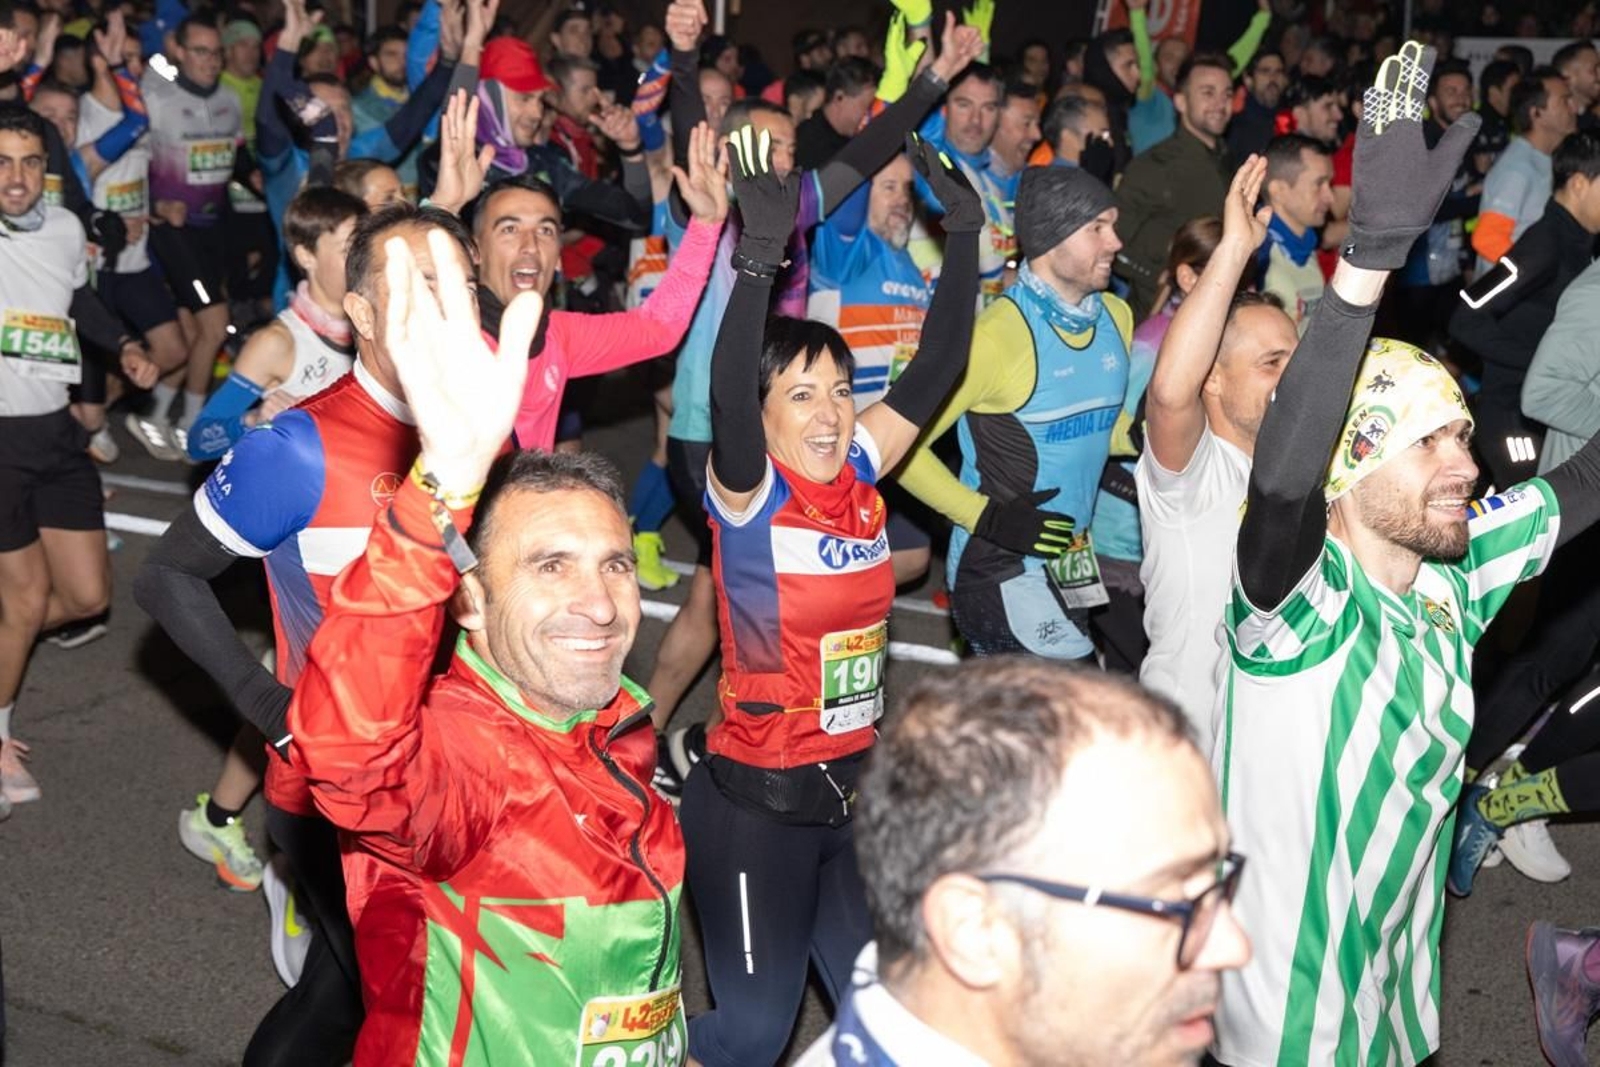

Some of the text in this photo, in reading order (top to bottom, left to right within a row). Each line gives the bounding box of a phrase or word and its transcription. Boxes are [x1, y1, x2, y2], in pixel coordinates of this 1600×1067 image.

[8, 328, 75, 359] 1544
[1045, 412, 1095, 444] MEDIA
[1344, 409, 1368, 447] JAEN
[846, 635, 865, 652] 42
[621, 1002, 653, 1033] 42
